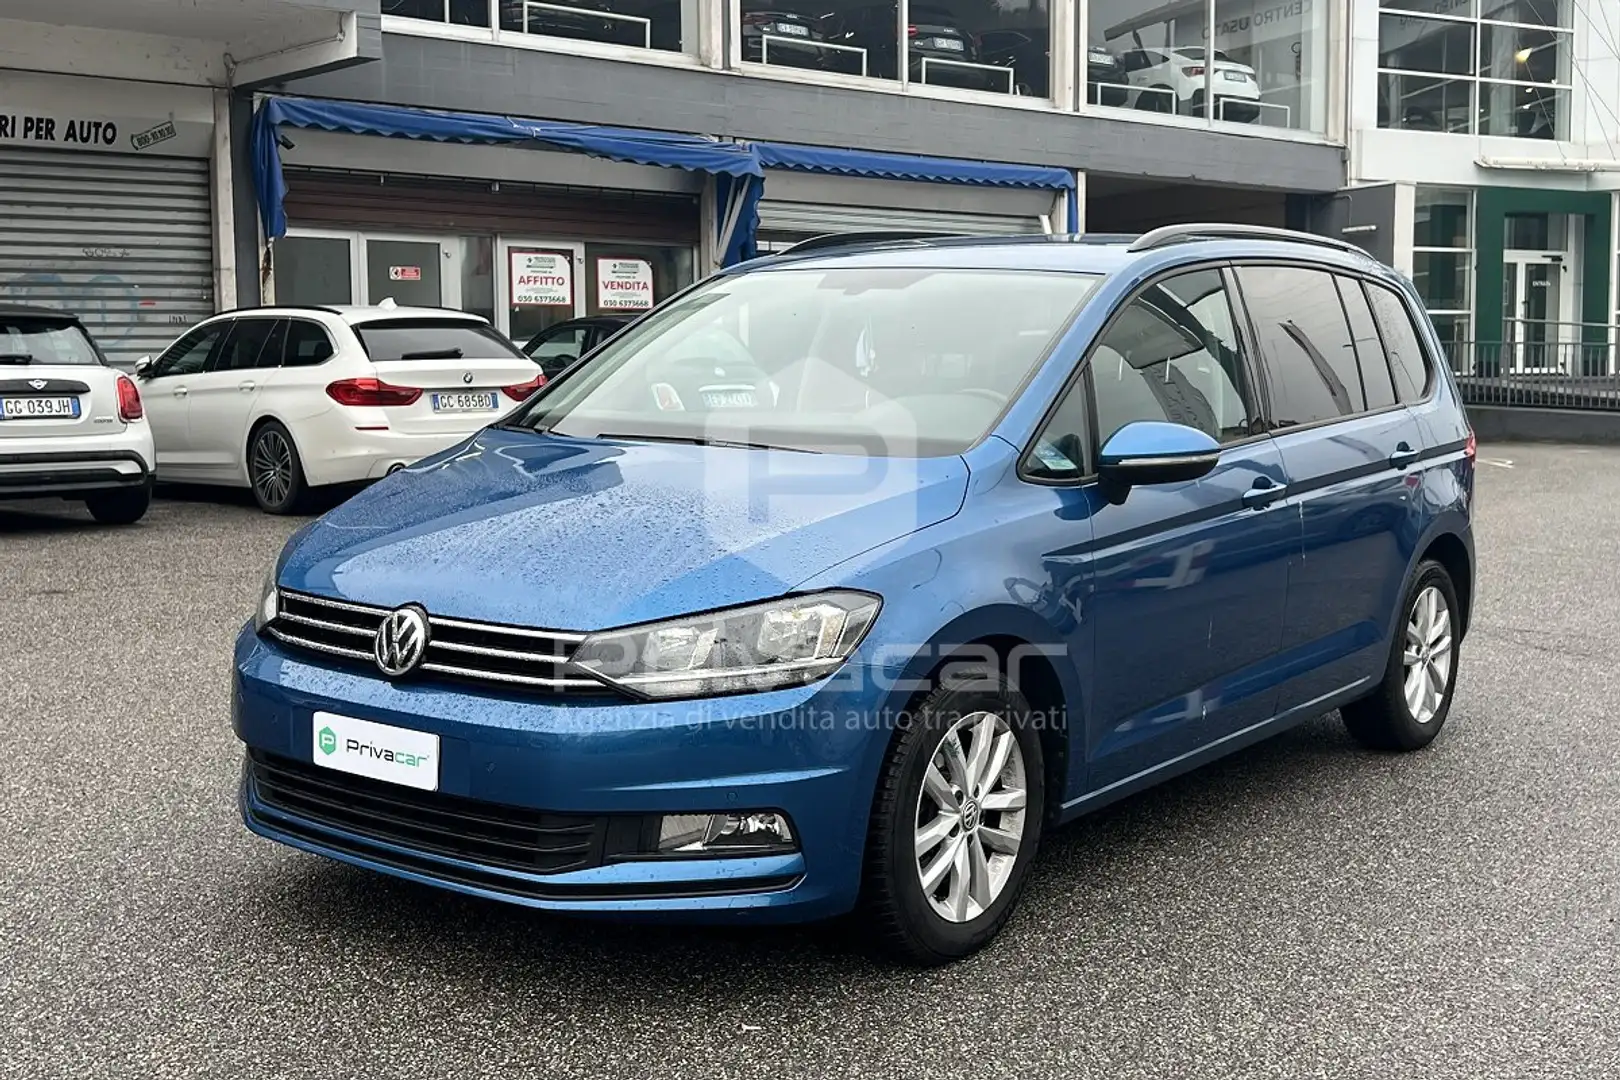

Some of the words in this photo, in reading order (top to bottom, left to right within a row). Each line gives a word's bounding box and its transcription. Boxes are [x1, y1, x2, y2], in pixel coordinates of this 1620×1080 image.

[23, 116, 56, 141] PER
[64, 120, 117, 145] AUTO
[518, 275, 565, 286] AFFITTO
[602, 280, 649, 290] VENDITA
